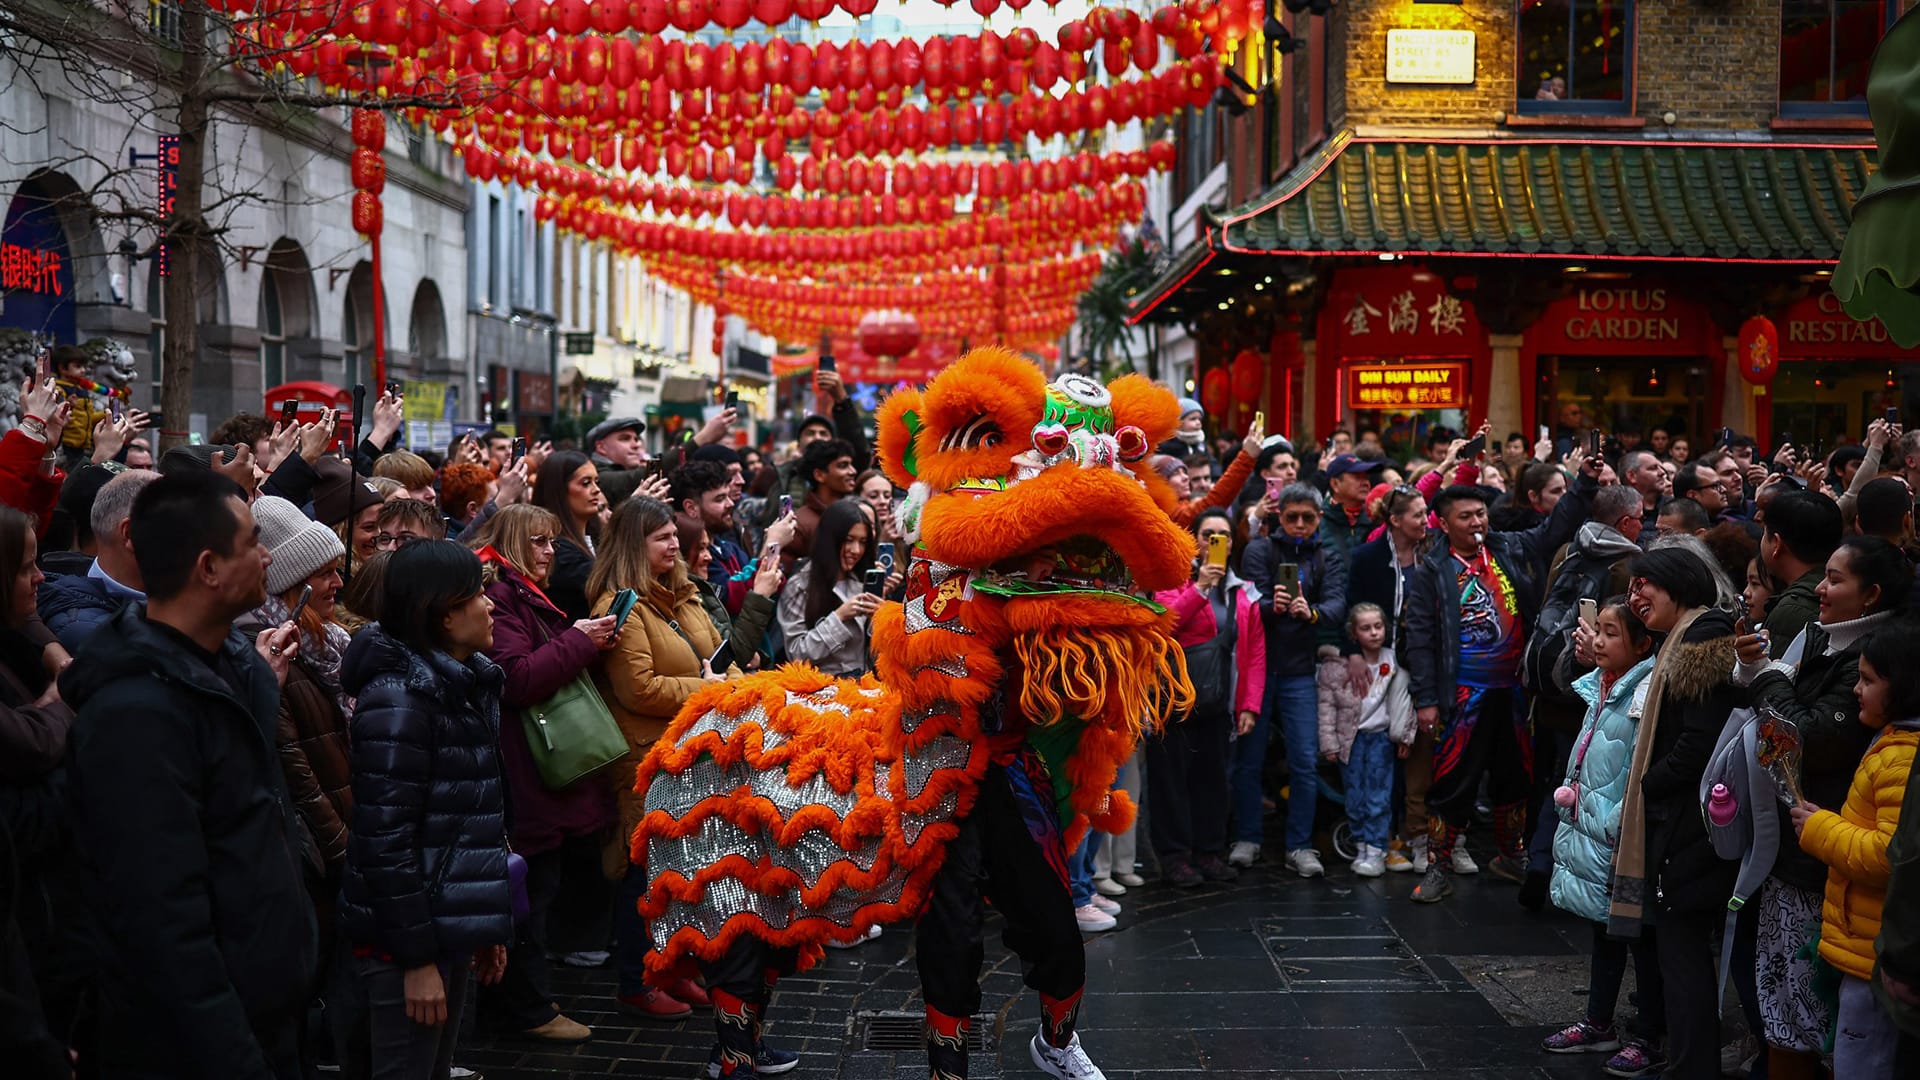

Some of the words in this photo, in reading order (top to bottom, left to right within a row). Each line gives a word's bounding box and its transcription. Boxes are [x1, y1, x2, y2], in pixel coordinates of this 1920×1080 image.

[1578, 288, 1667, 312] LOTUS
[1565, 317, 1679, 340] GARDEN
[1359, 371, 1382, 384] DIM
[1384, 371, 1411, 383] SUM
[1413, 370, 1449, 383] DAILY
